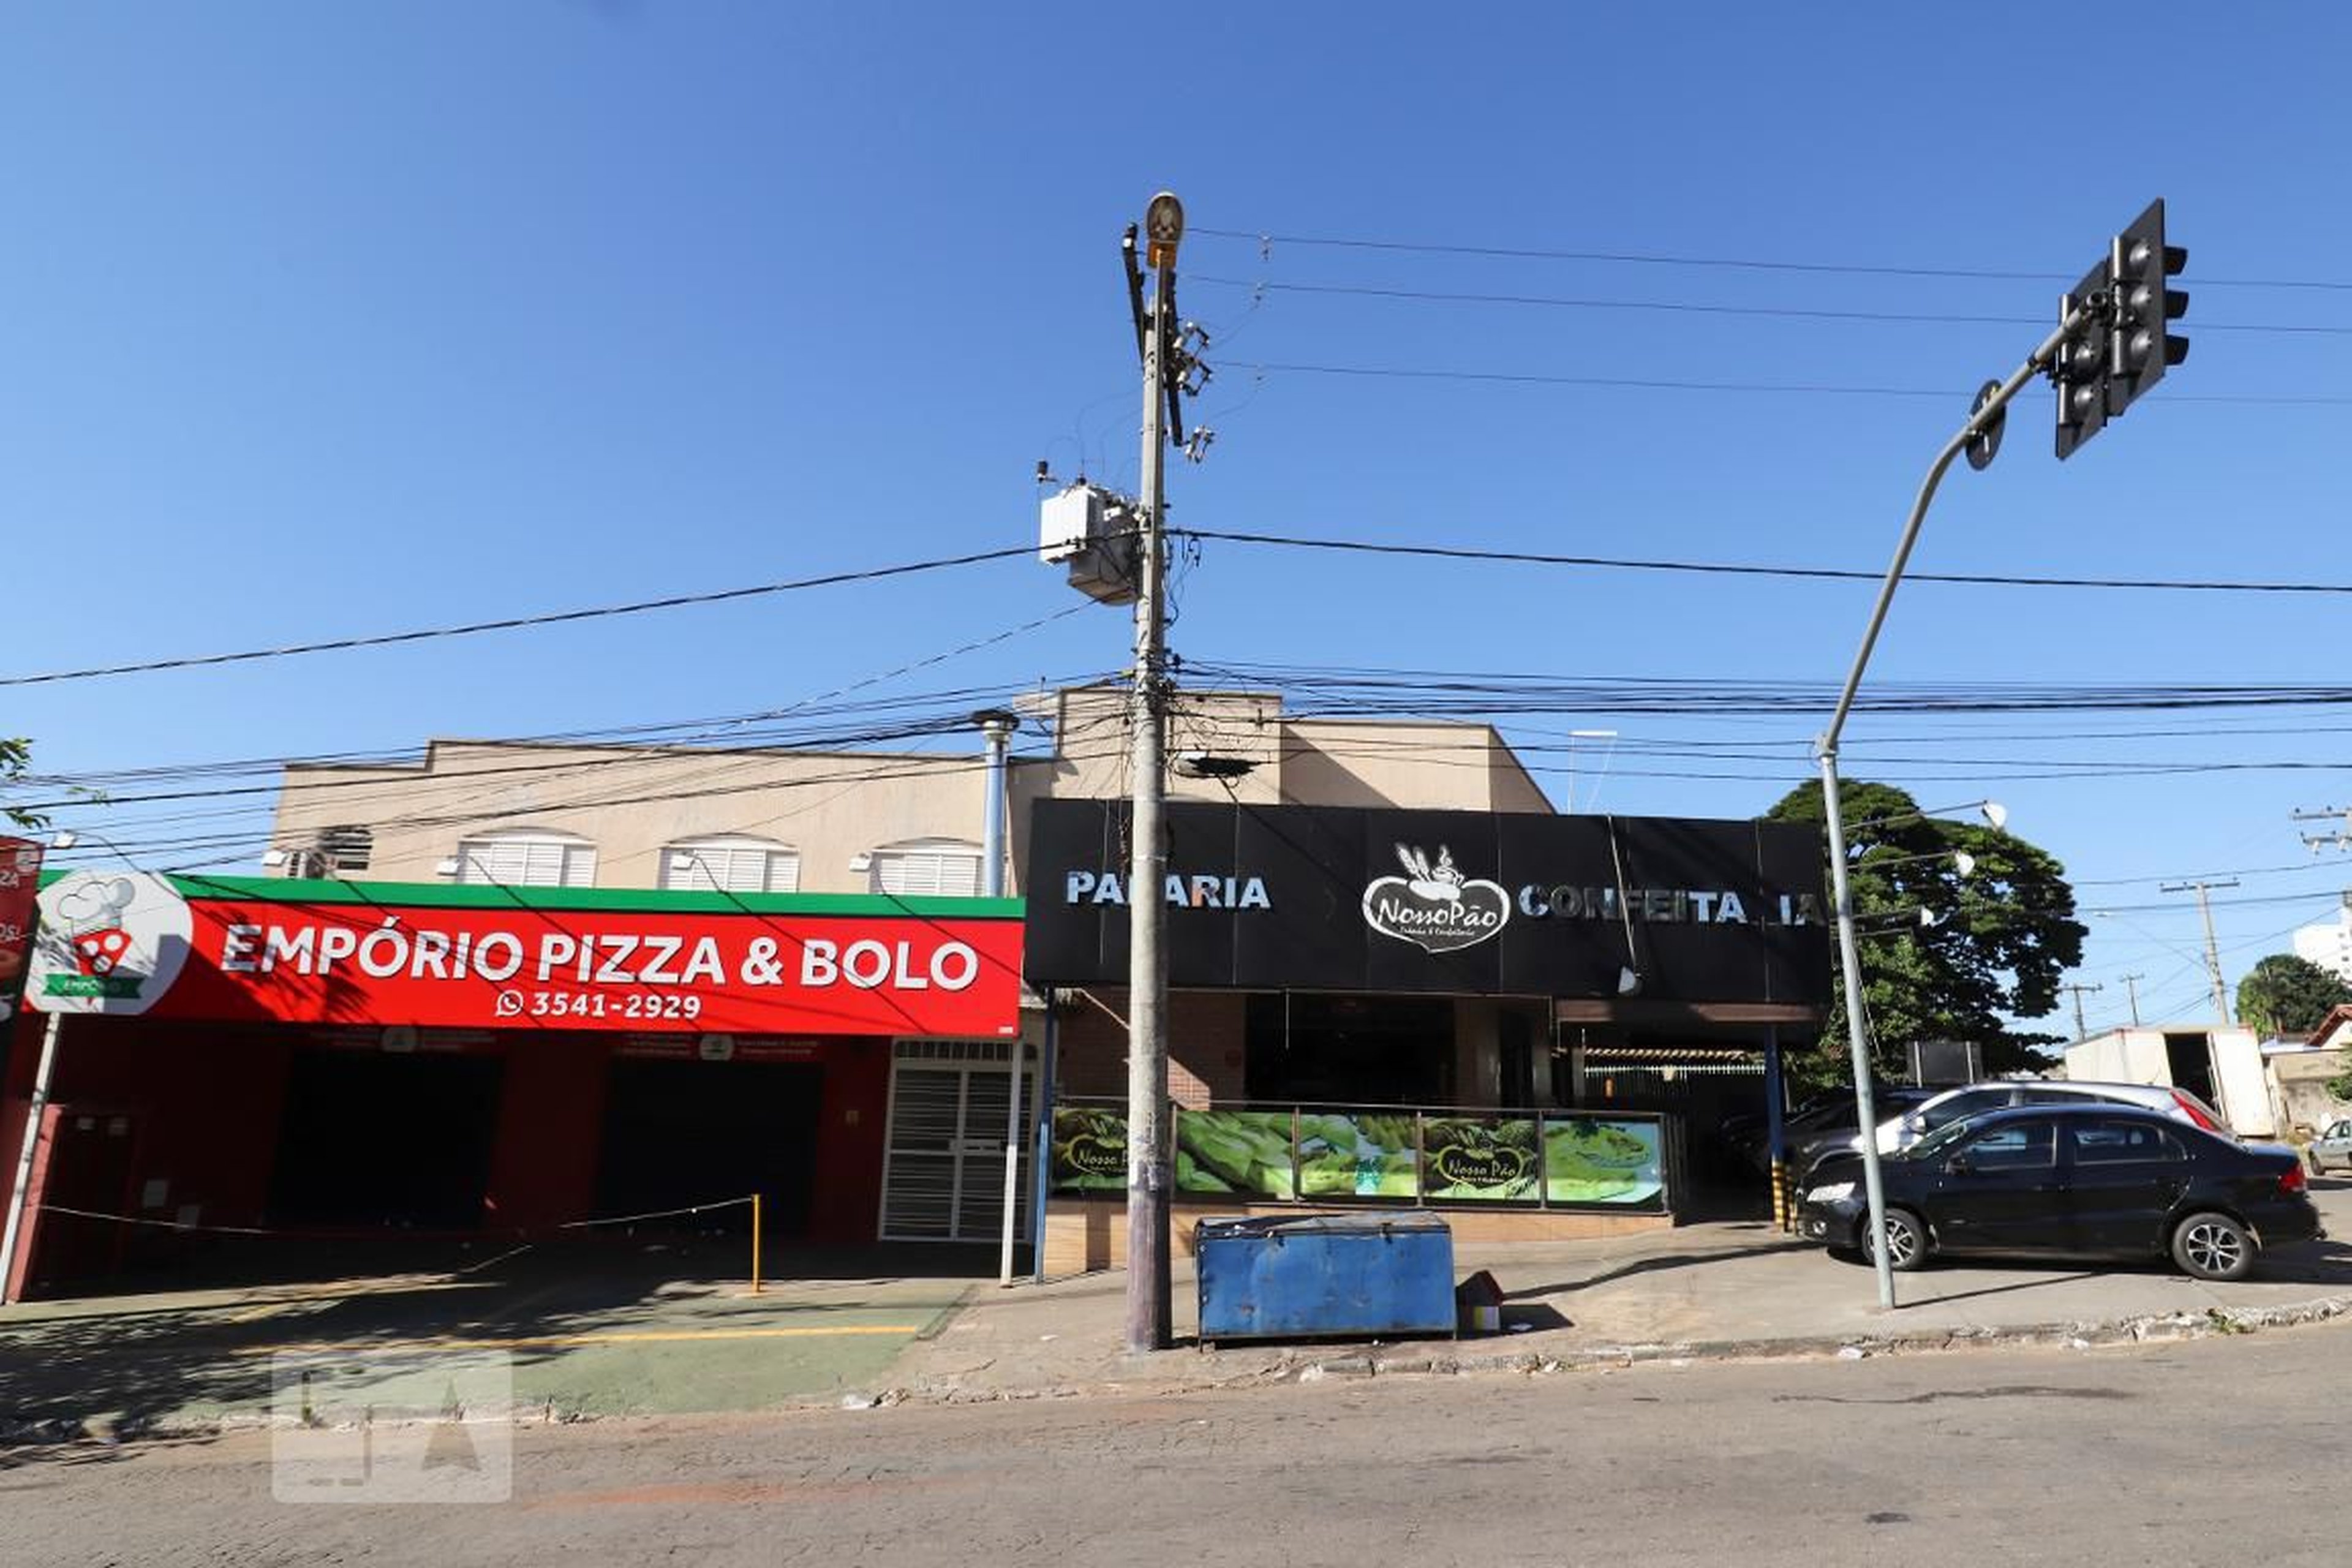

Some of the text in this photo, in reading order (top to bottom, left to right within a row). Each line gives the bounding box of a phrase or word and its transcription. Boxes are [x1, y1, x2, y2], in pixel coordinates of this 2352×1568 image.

[1067, 870, 1272, 908] PAARIA
[1518, 884, 1827, 926] CONFEITAIA
[221, 916, 979, 990] EMPÓRIO PIZZA & BOLO
[530, 992, 701, 1019] 3541-2929
